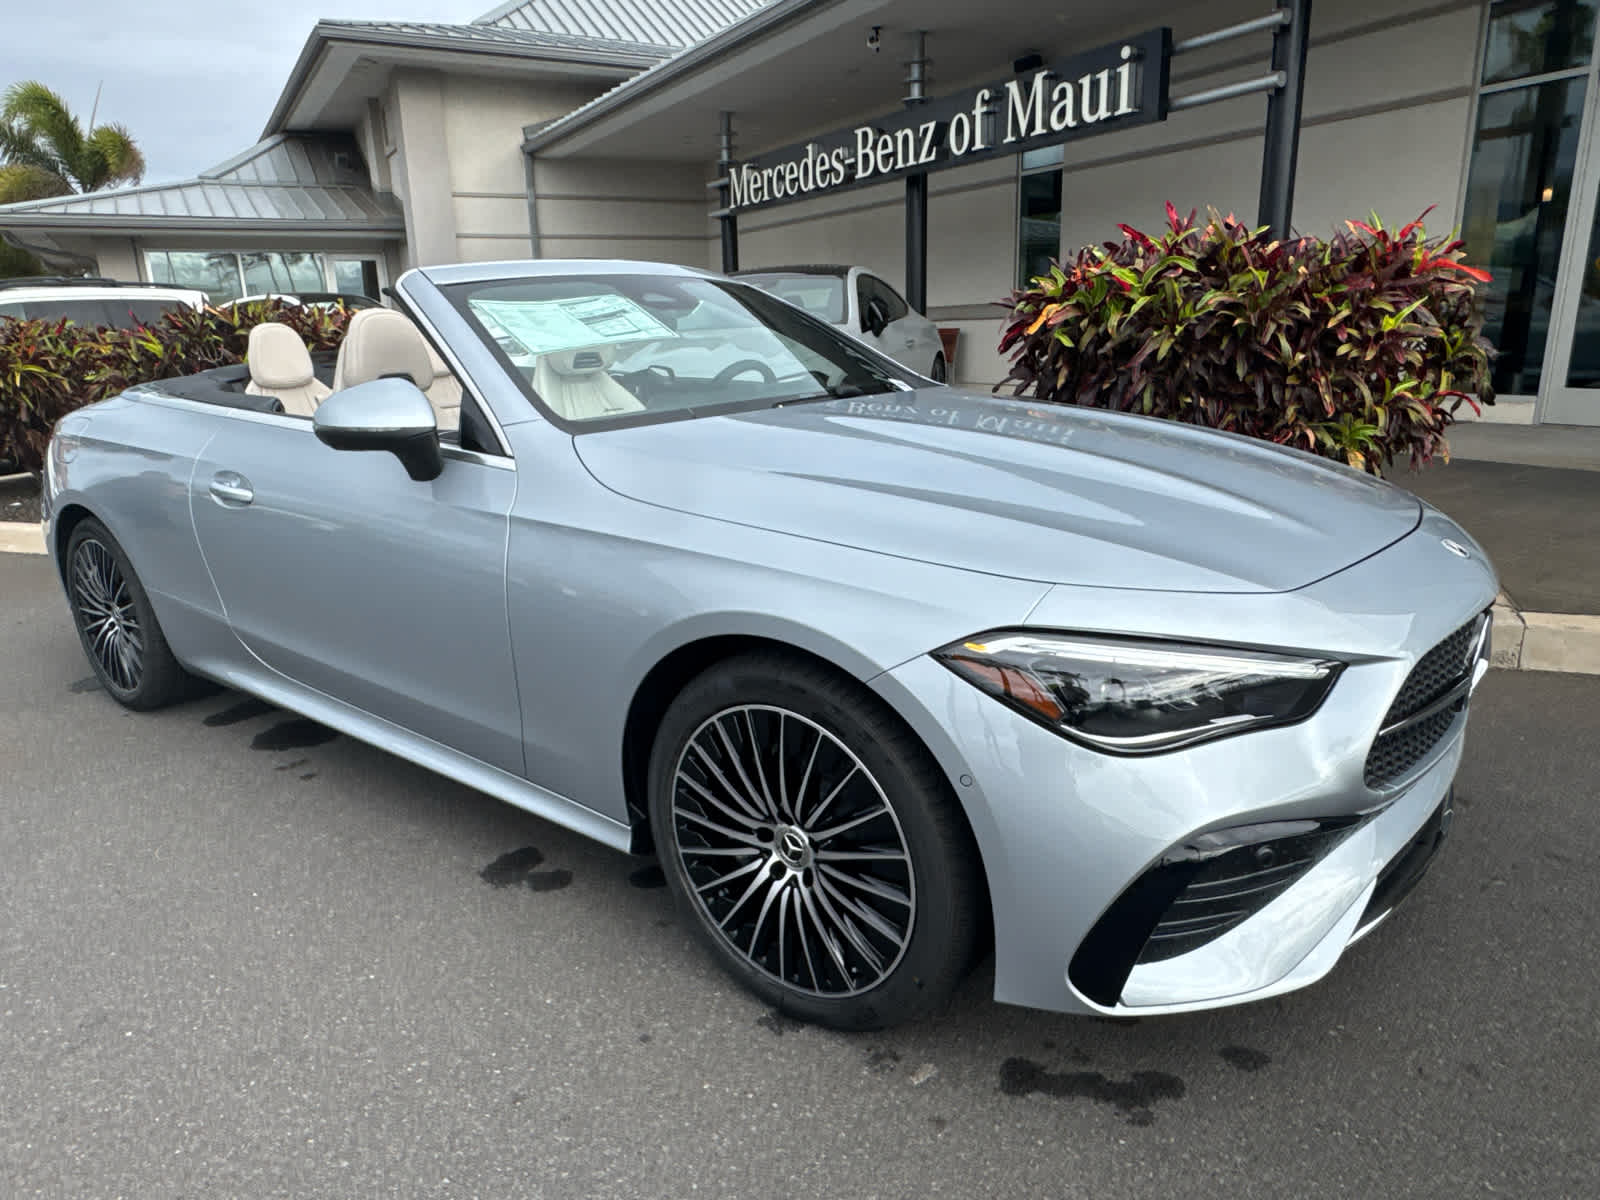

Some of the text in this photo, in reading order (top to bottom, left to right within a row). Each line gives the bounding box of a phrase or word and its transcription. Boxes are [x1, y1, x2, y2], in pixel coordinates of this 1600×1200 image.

[729, 45, 1135, 208] Mercedes-Benz of Maui
